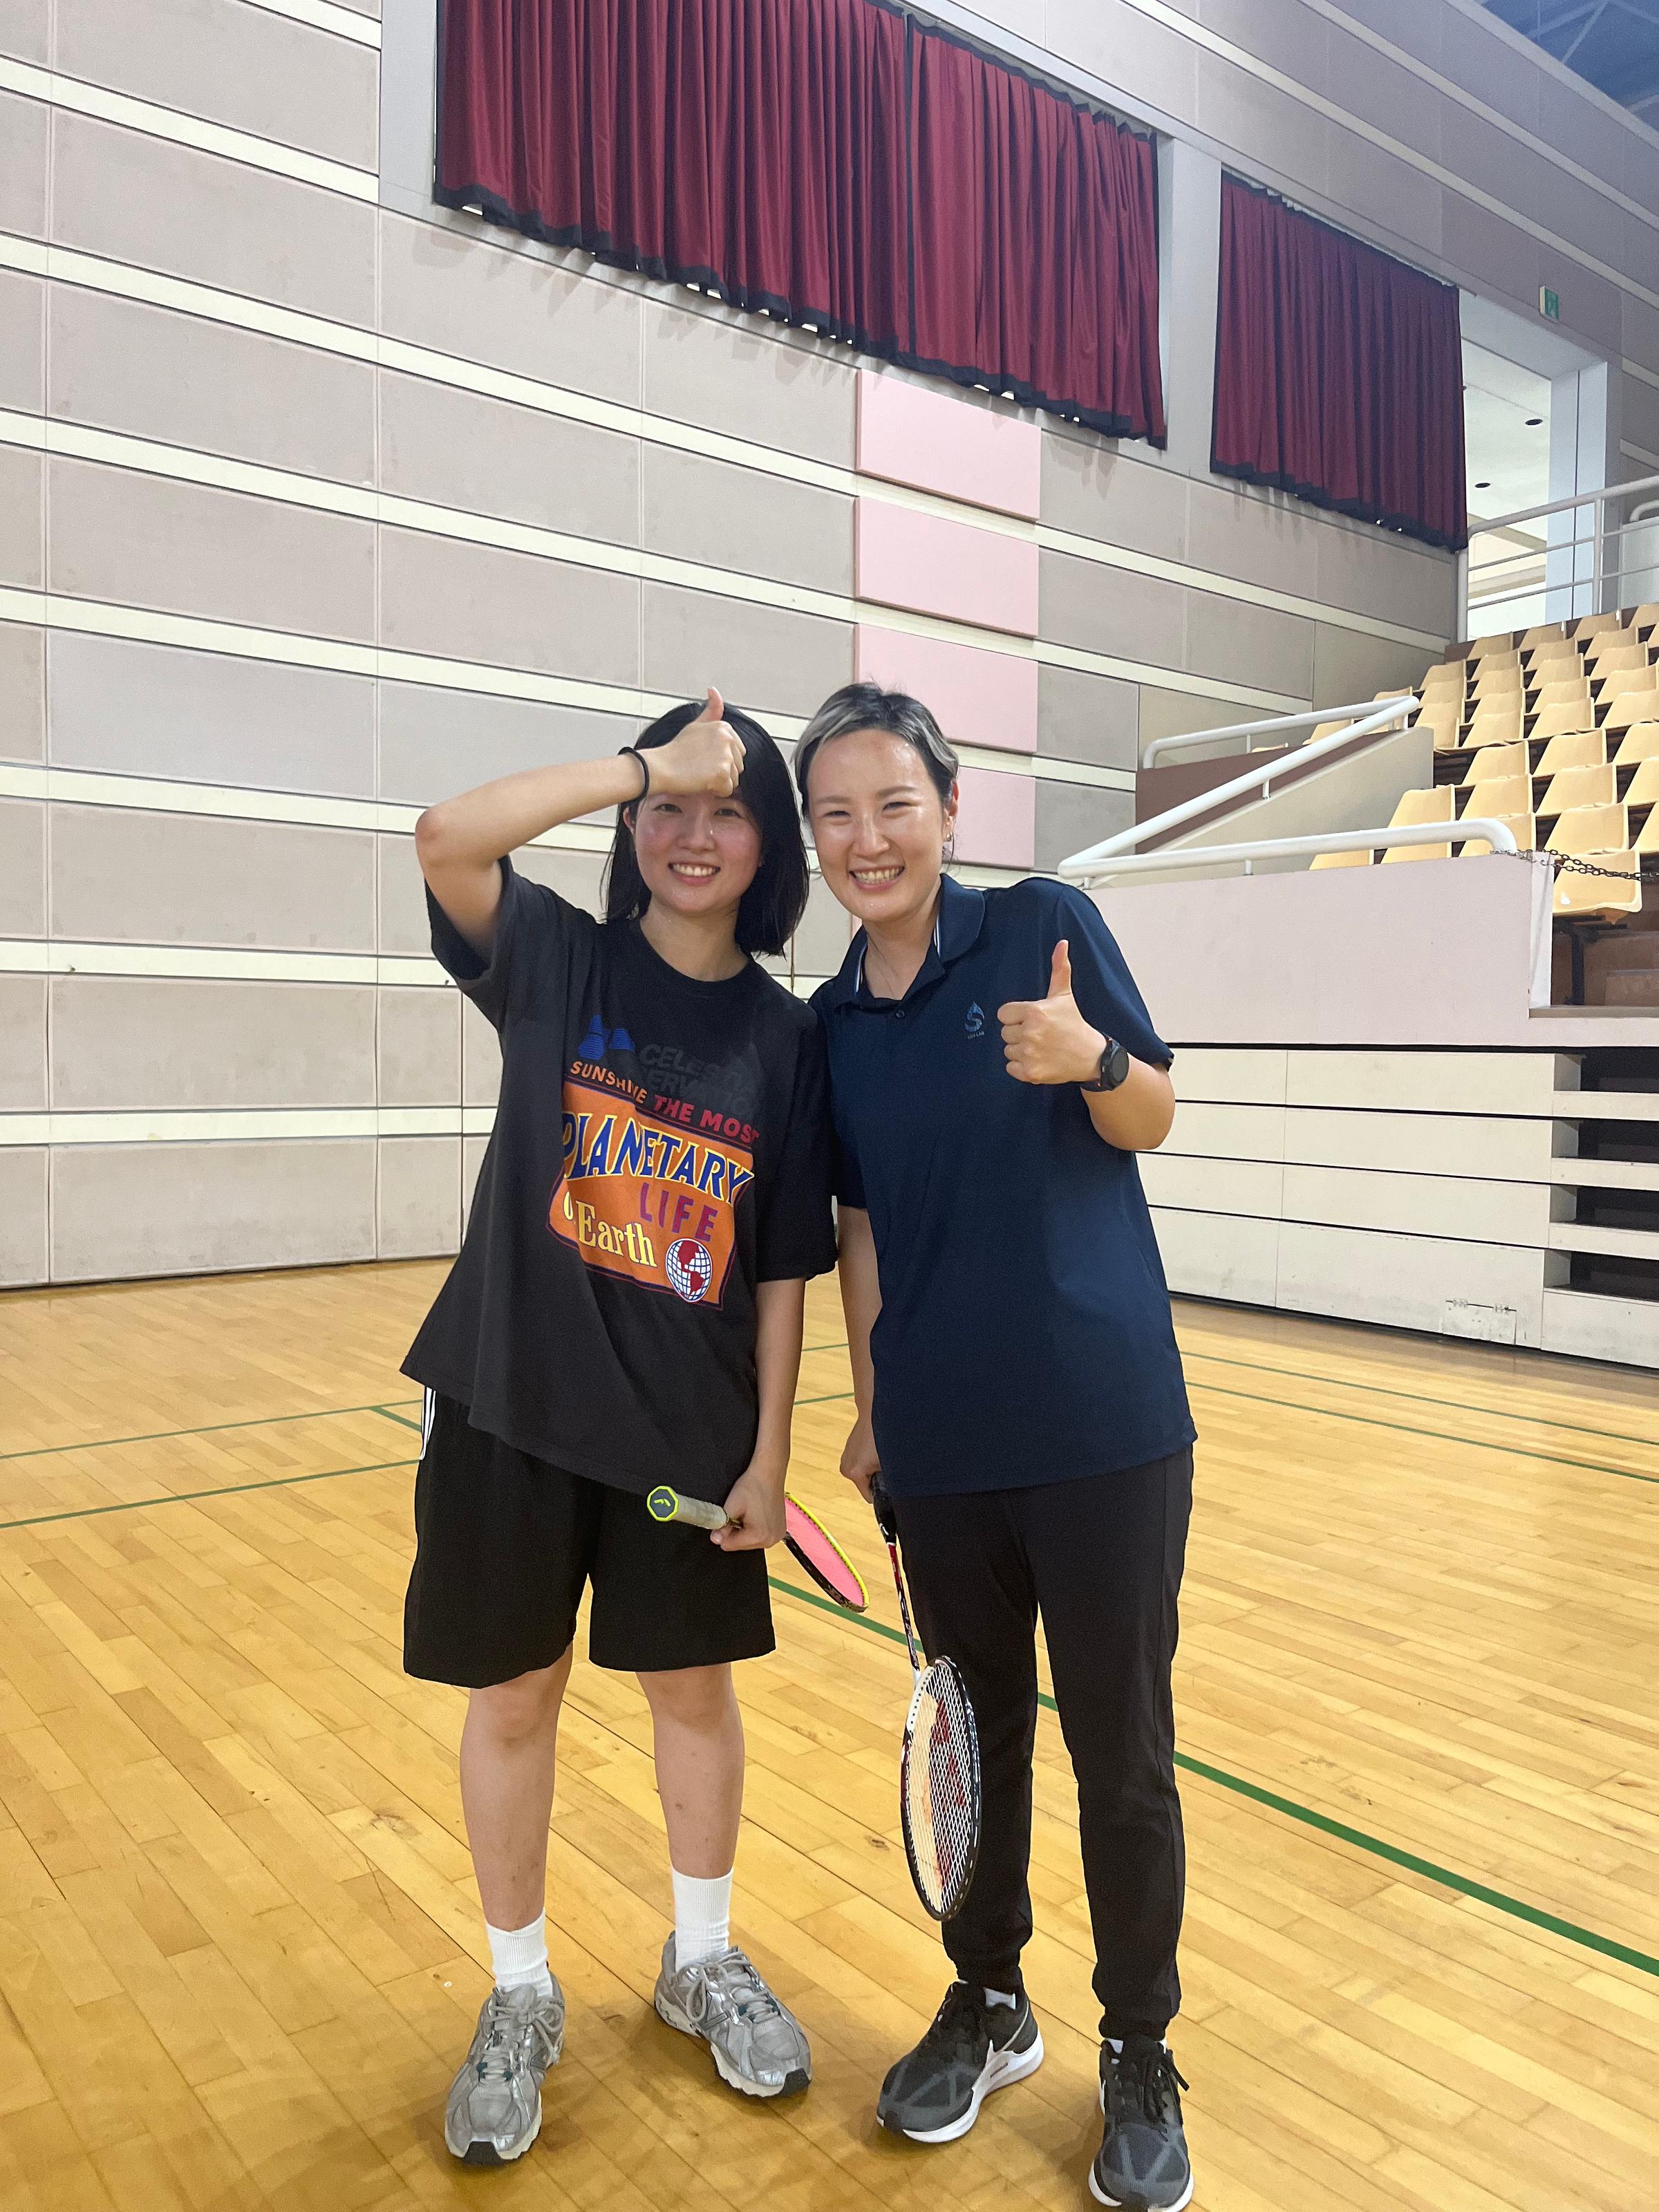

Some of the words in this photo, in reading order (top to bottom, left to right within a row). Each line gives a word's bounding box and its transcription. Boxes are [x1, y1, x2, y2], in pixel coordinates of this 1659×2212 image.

[654, 1094, 695, 1123] THE
[562, 1112, 754, 1205] PLANETARY
[575, 1200, 657, 1268] Earth
[638, 1183, 718, 1242] LIFE
